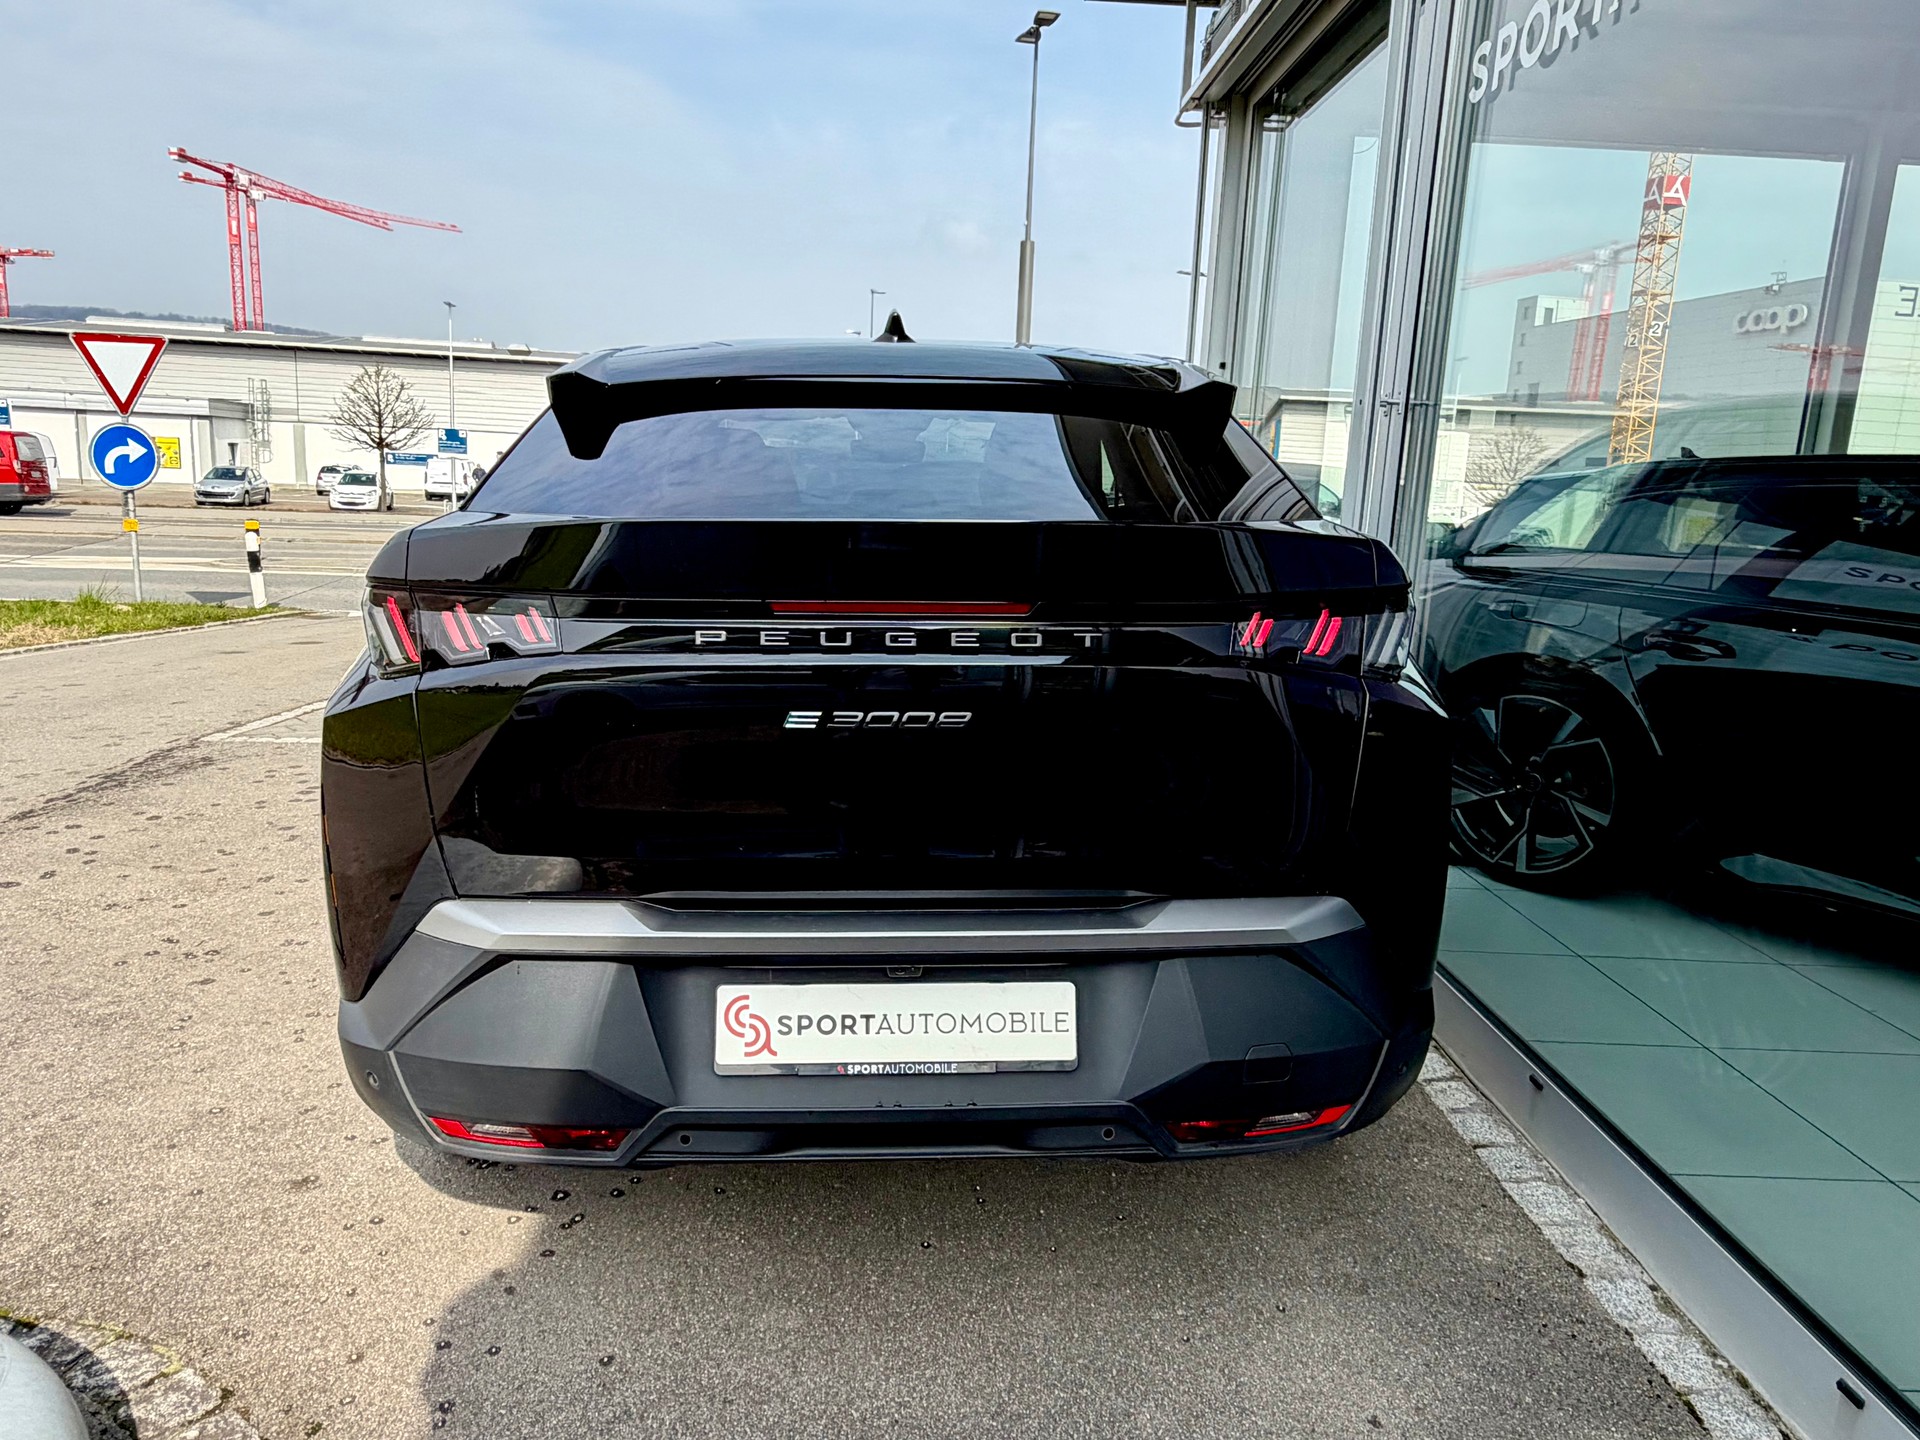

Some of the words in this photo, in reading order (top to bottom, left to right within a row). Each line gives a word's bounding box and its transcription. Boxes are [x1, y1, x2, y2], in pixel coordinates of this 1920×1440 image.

[1733, 304, 1808, 335] coop
[1651, 323, 1661, 334] 2
[695, 631, 1103, 647] PEUGEOT
[777, 1011, 1070, 1036] SPORTAUTOMOBILE
[847, 1062, 958, 1075] SPORTAUTOMOBILE
